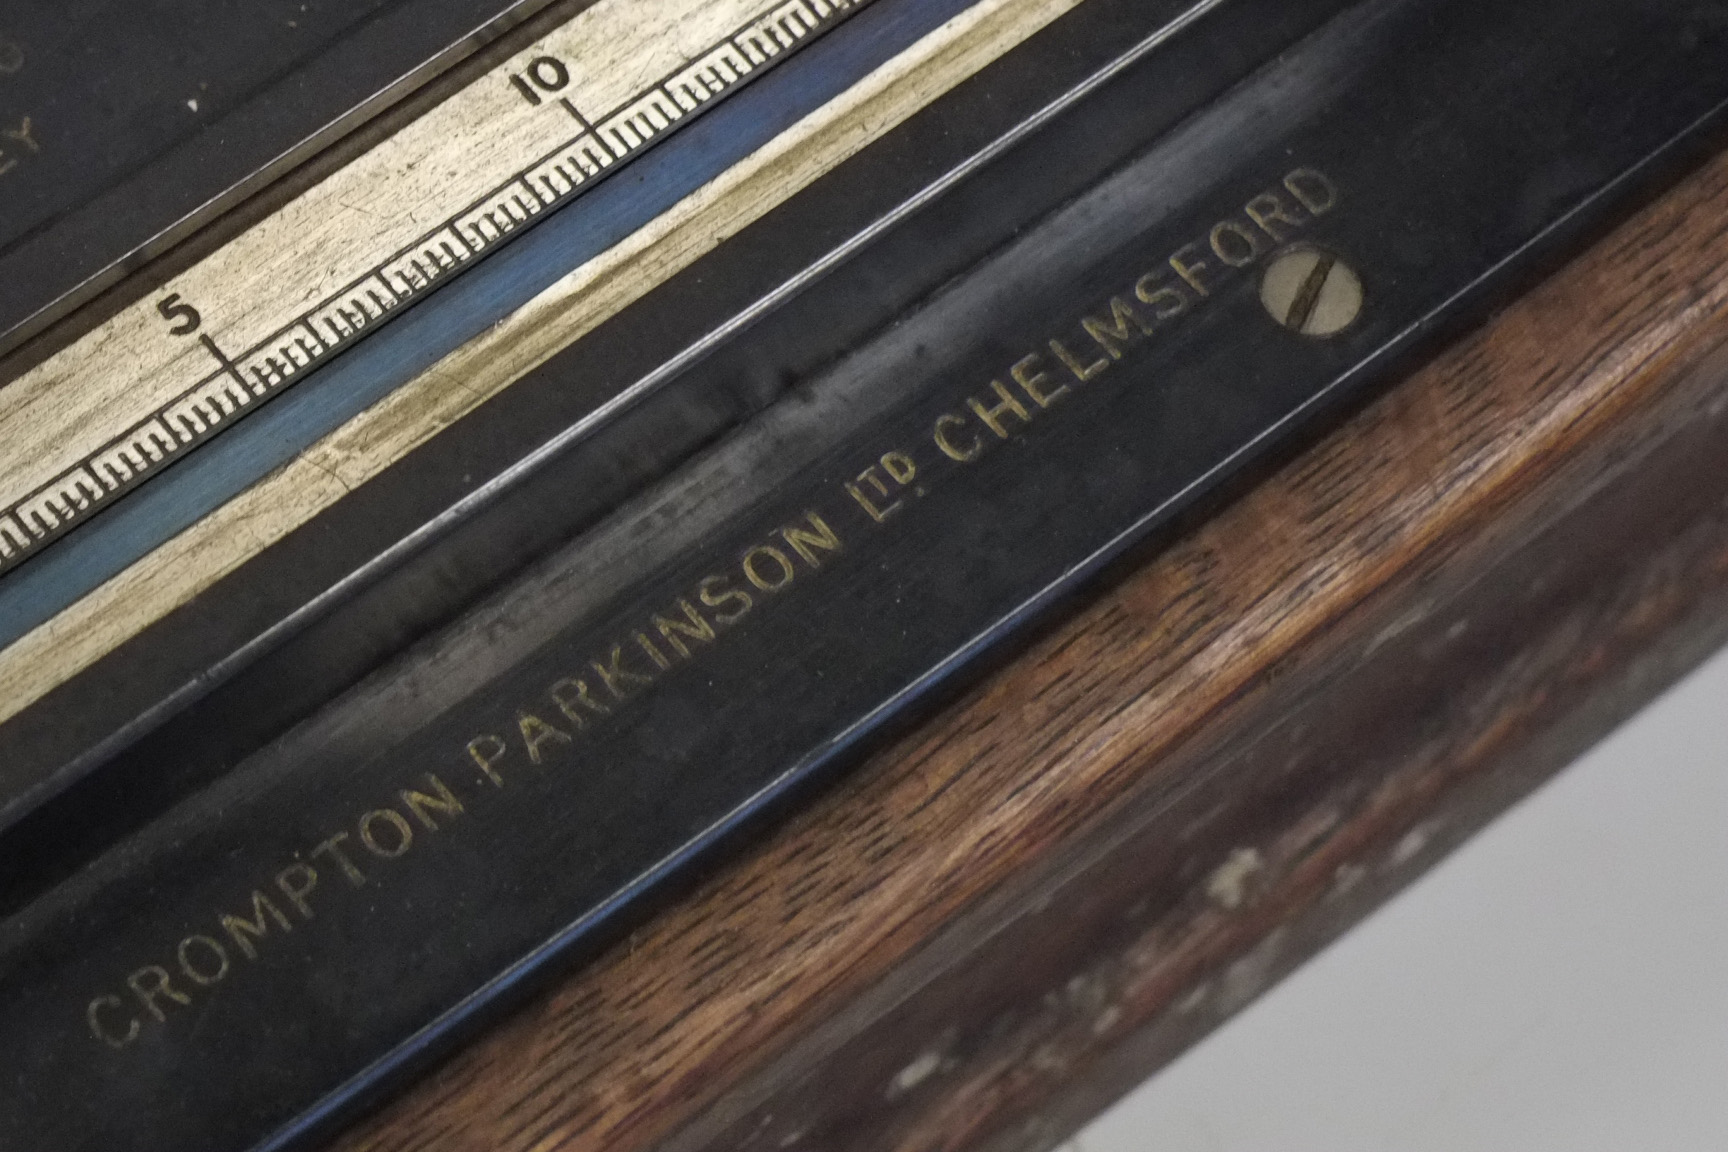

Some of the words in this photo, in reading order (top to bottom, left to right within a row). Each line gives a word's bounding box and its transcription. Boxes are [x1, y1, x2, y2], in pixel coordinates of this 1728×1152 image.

[509, 53, 571, 104] 10
[157, 292, 202, 336] 5
[85, 769, 466, 1053] CROMPTON
[467, 510, 842, 788] PARKINSON
[933, 165, 1340, 462] CHELMSFORD
